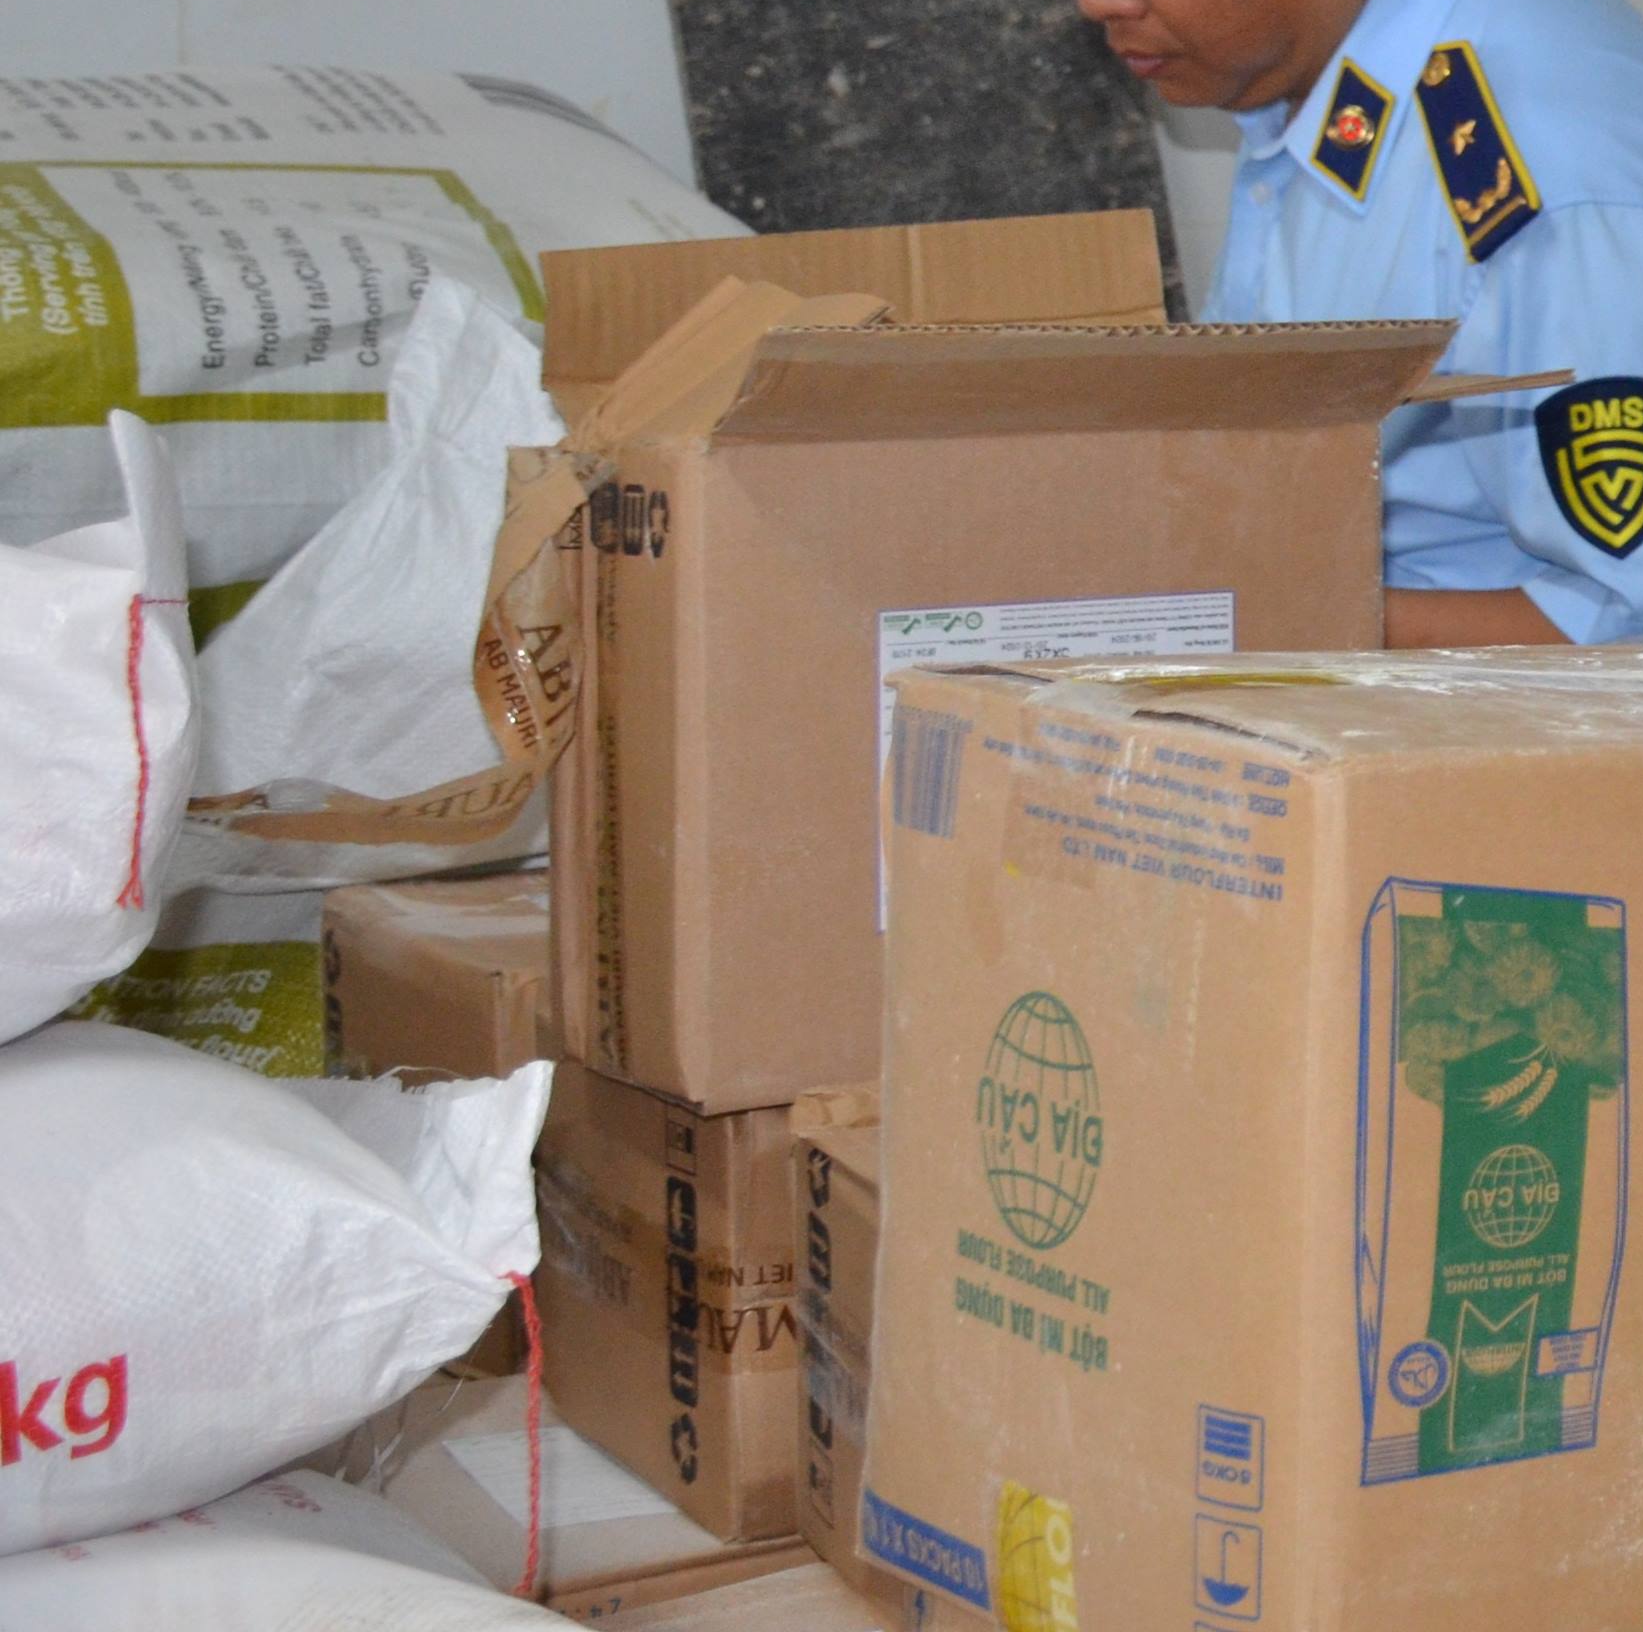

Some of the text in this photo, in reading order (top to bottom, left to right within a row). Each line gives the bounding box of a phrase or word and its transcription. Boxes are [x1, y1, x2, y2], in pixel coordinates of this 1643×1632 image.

[1169, 861, 1283, 902] INTERFLOUR
[976, 1074, 1104, 1168] ĐỊA CẦU
[957, 1227, 1003, 1272] FLOUR
[955, 1275, 1004, 1329] DỤNG
[1070, 1322, 1109, 1372] BỘT
[0, 1352, 128, 1466] kg
